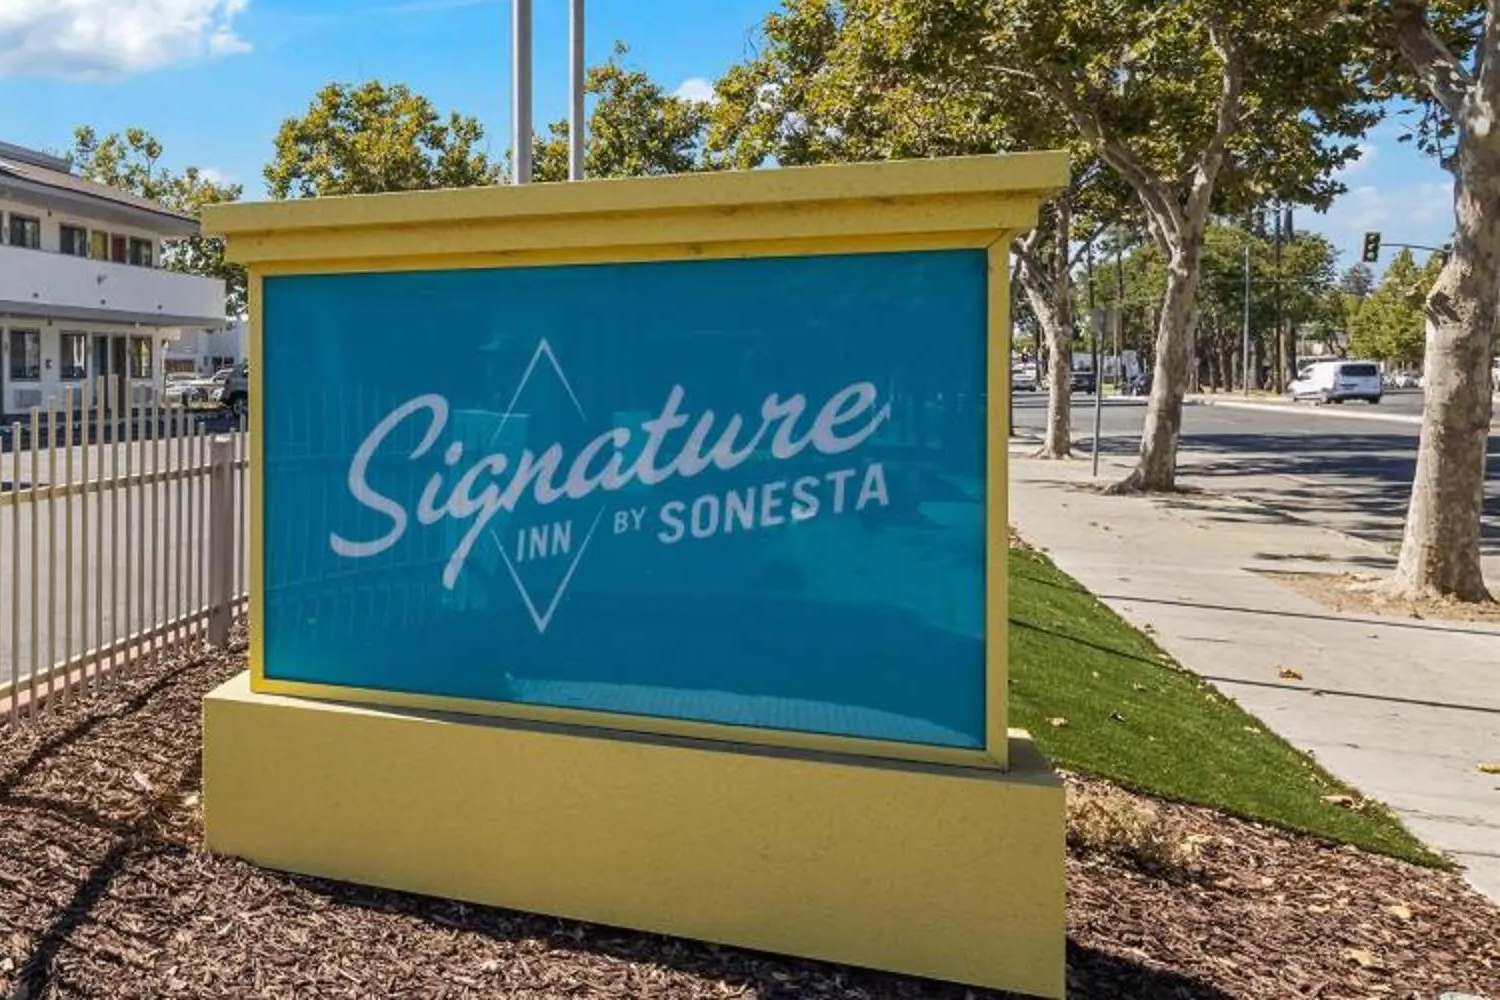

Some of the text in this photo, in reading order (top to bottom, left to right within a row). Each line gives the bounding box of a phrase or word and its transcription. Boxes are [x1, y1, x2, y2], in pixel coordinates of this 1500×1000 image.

[329, 381, 891, 590] Signature
[516, 463, 889, 562] INN BY SONESTA
